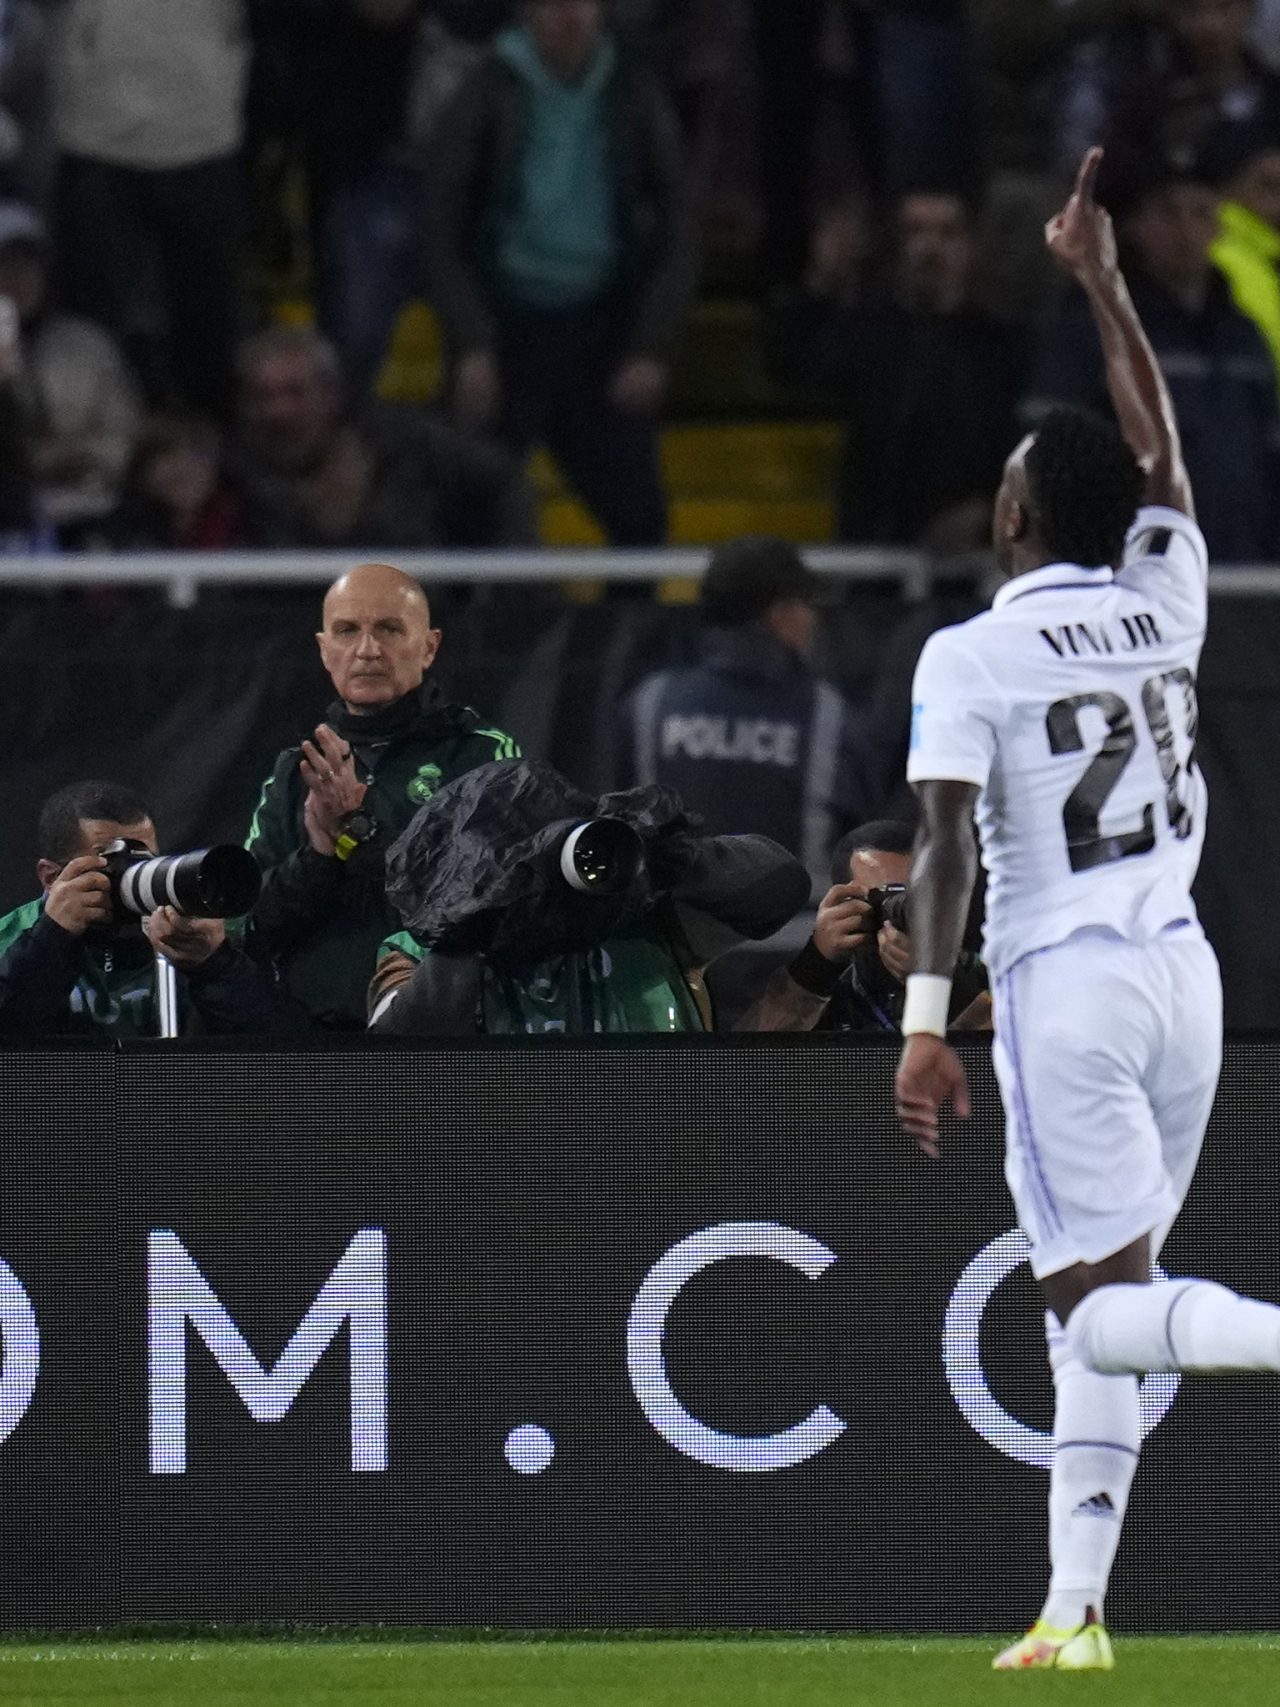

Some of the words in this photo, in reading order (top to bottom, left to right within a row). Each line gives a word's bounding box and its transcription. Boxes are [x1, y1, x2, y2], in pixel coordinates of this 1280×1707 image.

[1119, 612, 1163, 652] JR
[662, 713, 799, 766] POLICE
[1046, 667, 1199, 873] 20
